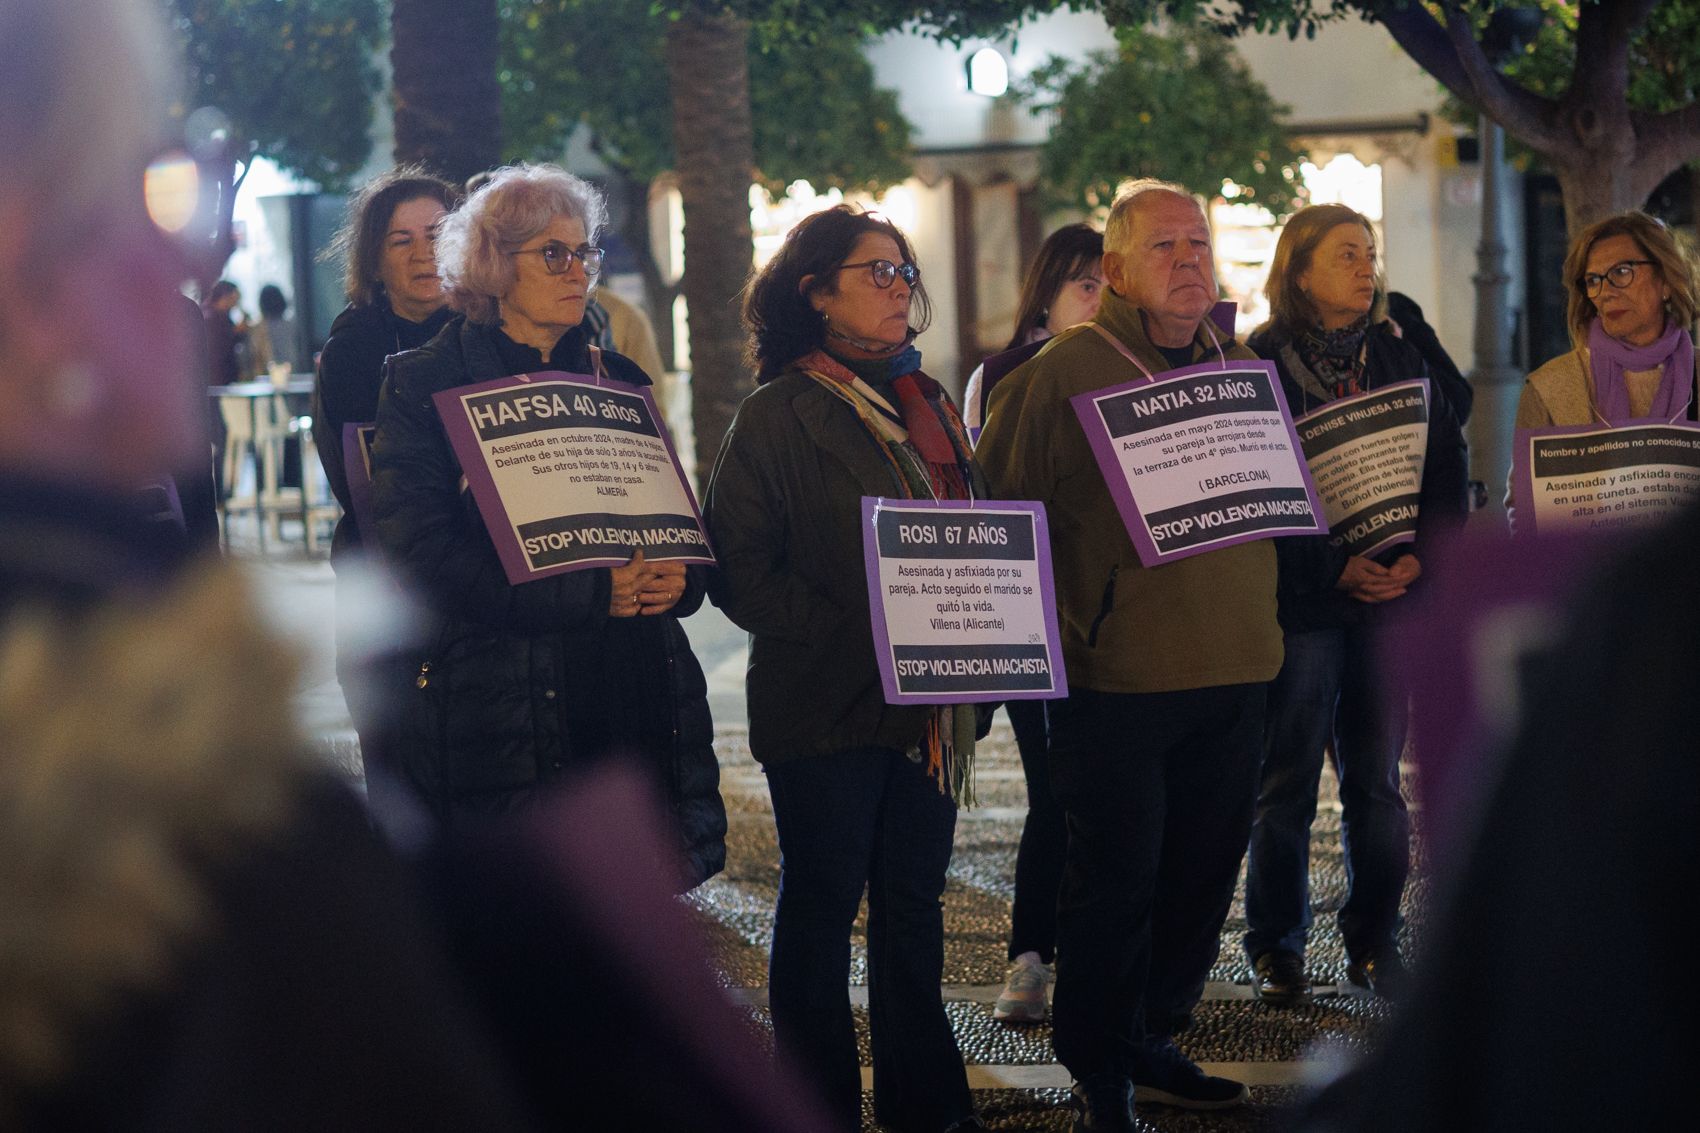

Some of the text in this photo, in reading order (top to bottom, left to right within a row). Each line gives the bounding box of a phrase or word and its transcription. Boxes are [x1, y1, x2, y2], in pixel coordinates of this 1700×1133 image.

[1132, 379, 1256, 418] NATIA 32 AÑOS
[472, 393, 641, 429] HAFSA 40 años
[1306, 417, 1346, 440] DENISE
[1345, 403, 1392, 423] VINUESA
[1392, 399, 1404, 410] 32
[1123, 416, 1280, 451] Asesinada en mayo 2024 después de que
[1162, 430, 1266, 455] su pareja la arrojara desde
[491, 438, 544, 456] Asesinada
[547, 437, 559, 445] en
[560, 434, 593, 444] octubre
[594, 434, 615, 444] 2024,
[615, 436, 635, 446] madre
[635, 440, 643, 448] de
[644, 440, 649, 448] 4
[1344, 447, 1360, 457] con
[1361, 438, 1390, 451] fuertes
[1540, 448, 1578, 458] Nombre
[1579, 448, 1586, 456] y
[1587, 441, 1630, 455] apellidos
[1632, 439, 1644, 448] no
[1647, 438, 1691, 448] conocidos
[495, 454, 536, 468] Delante
[538, 450, 551, 460] de
[553, 450, 565, 458] su
[566, 447, 582, 457] hija
[584, 447, 594, 456] de
[596, 446, 611, 456] sólo
[612, 448, 617, 456] 3
[619, 448, 636, 458] años
[637, 450, 643, 458] la
[532, 460, 660, 475] Sus otros hijos de 19, 14 y 6 años
[1133, 467, 1143, 476] la
[1144, 460, 1179, 473] terraza
[1181, 455, 1193, 464] de
[1194, 452, 1207, 461] un
[1219, 446, 1239, 457] piso.
[1239, 442, 1259, 452] Murió
[1268, 442, 1274, 450] el
[1359, 464, 1376, 475] Ella
[1376, 456, 1404, 468] estaba
[583, 473, 613, 482] estaban
[624, 476, 644, 484] casa.
[1318, 473, 1329, 482] un
[1331, 460, 1358, 475] objeto
[1545, 477, 1606, 492] Asesinada
[1609, 476, 1616, 486] y
[1619, 469, 1670, 482] asfixiada
[1338, 473, 1380, 498] programa
[1381, 470, 1392, 479] de
[1553, 495, 1568, 505] en
[1571, 493, 1594, 503] una
[1596, 486, 1640, 501] cuneta.
[1643, 483, 1681, 493] estaba
[1342, 489, 1372, 510] Buñol
[1572, 504, 1594, 518] alta
[1597, 504, 1612, 514] en
[1615, 501, 1625, 512] el
[1628, 498, 1667, 510] sitema
[1151, 500, 1312, 541] STOP VIOLENCIA MACHISTA
[1344, 505, 1411, 544] VIOLENCIA
[524, 528, 707, 554] STOP VIOLENCIA MACHISTA
[899, 522, 1008, 545] ROSI 67 AÑOS
[898, 565, 1022, 580] Asesinada y asfixiada por su
[888, 584, 1033, 597] pareja. Acto seguido el marido se
[936, 600, 995, 614] quitó la vida.
[930, 617, 1005, 632] Villena (Alicante)
[898, 658, 1049, 676] STOP VIOLENCIA MACHISTA
